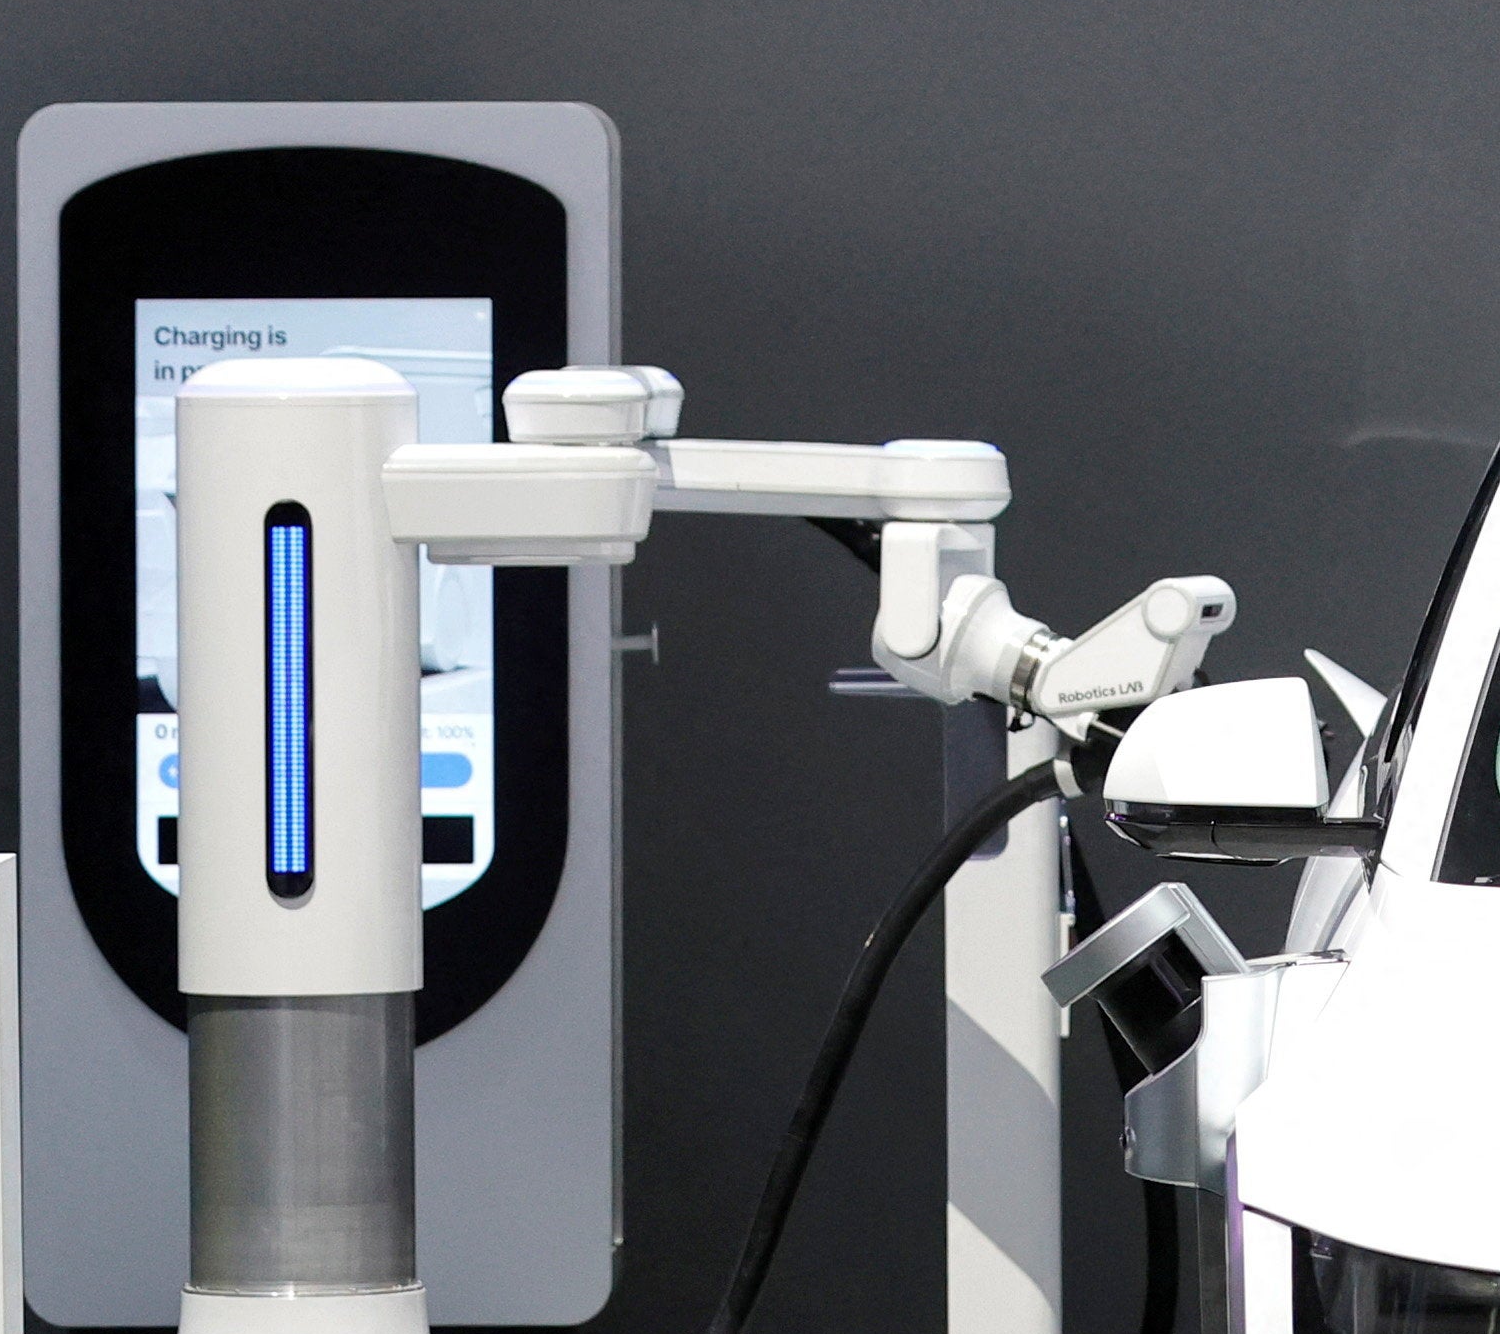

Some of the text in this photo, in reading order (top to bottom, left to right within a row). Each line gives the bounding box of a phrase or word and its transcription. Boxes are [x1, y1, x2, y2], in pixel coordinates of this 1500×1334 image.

[154, 325, 287, 351] Charging is
[154, 360, 175, 380] in
[1058, 685, 1117, 704] Robotics
